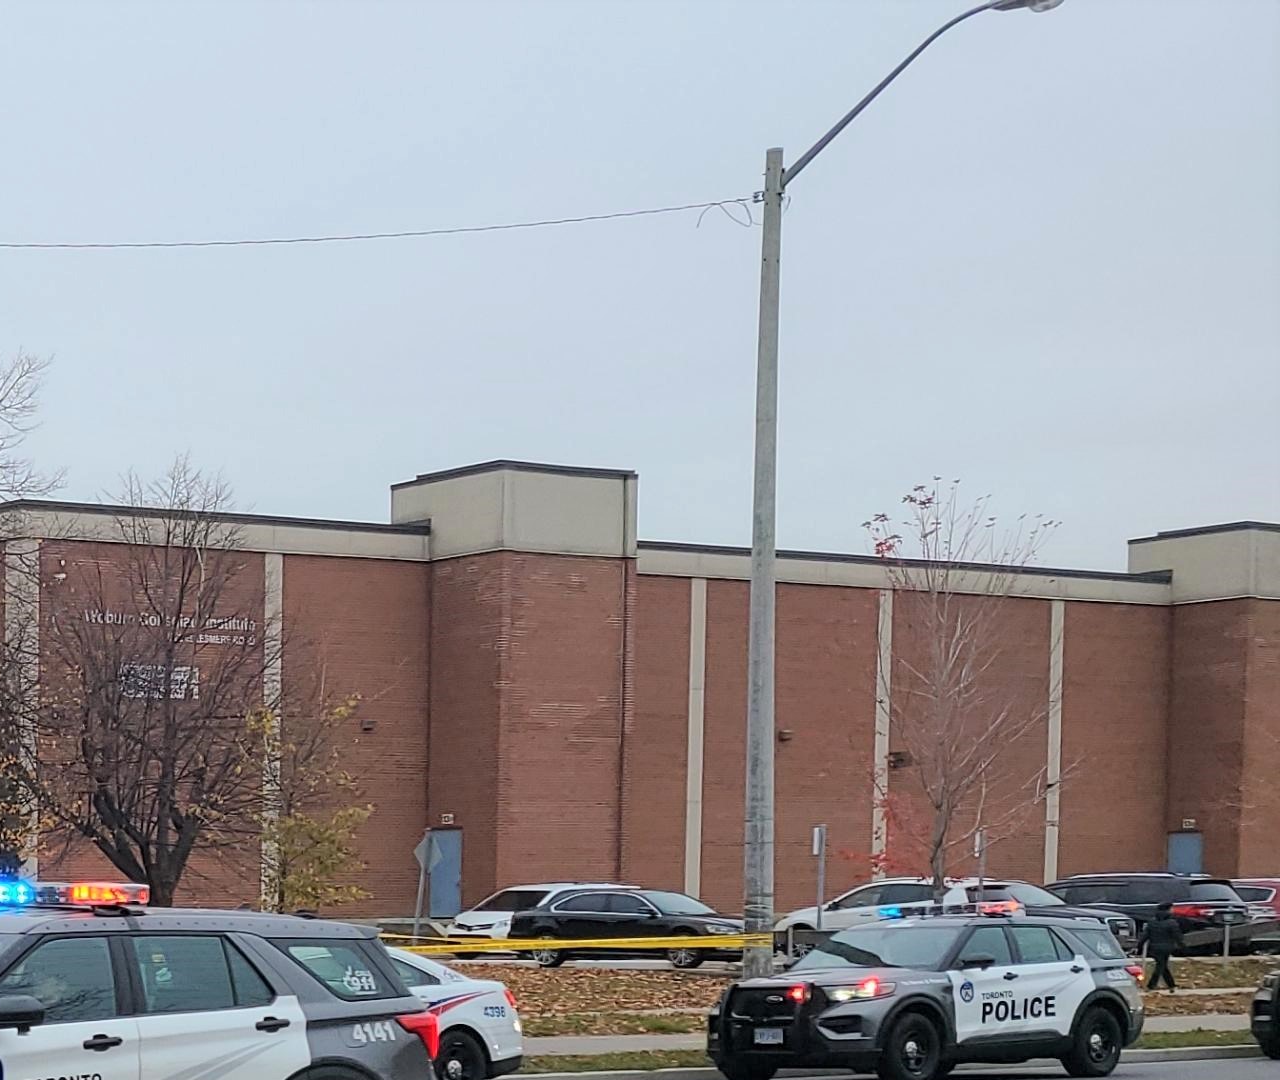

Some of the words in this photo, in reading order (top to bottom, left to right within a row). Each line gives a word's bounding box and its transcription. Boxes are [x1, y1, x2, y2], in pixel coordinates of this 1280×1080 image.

[350, 976, 377, 991] 911
[981, 990, 1014, 1000] TORONTO
[981, 995, 1056, 1024] POLICE
[352, 1021, 396, 1042] 4141
